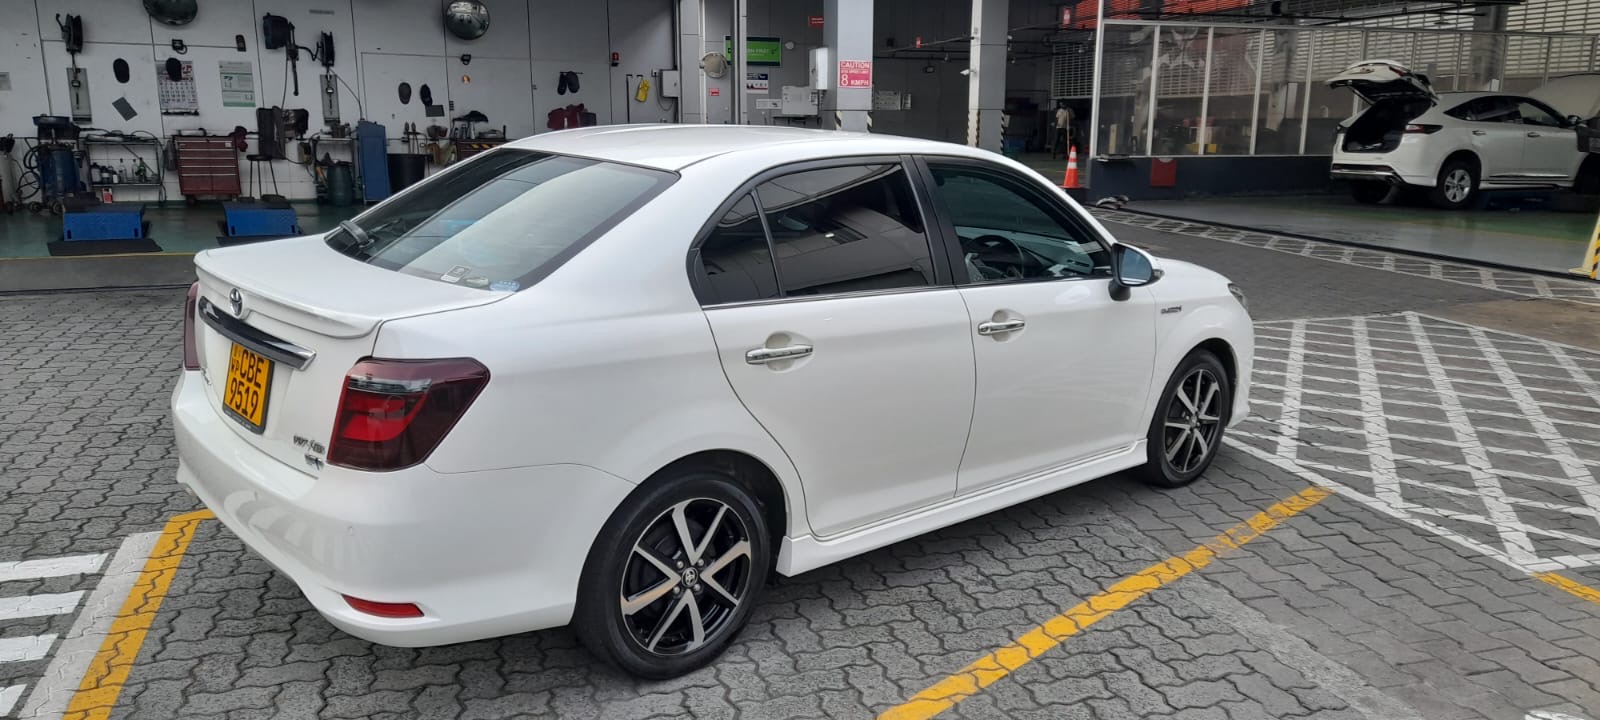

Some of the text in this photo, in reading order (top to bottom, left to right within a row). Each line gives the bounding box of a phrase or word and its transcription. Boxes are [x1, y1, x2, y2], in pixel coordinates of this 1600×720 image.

[840, 61, 870, 69] CAUTION
[841, 73, 849, 86] 8
[240, 349, 264, 389] CBE
[229, 377, 259, 419] 9519
